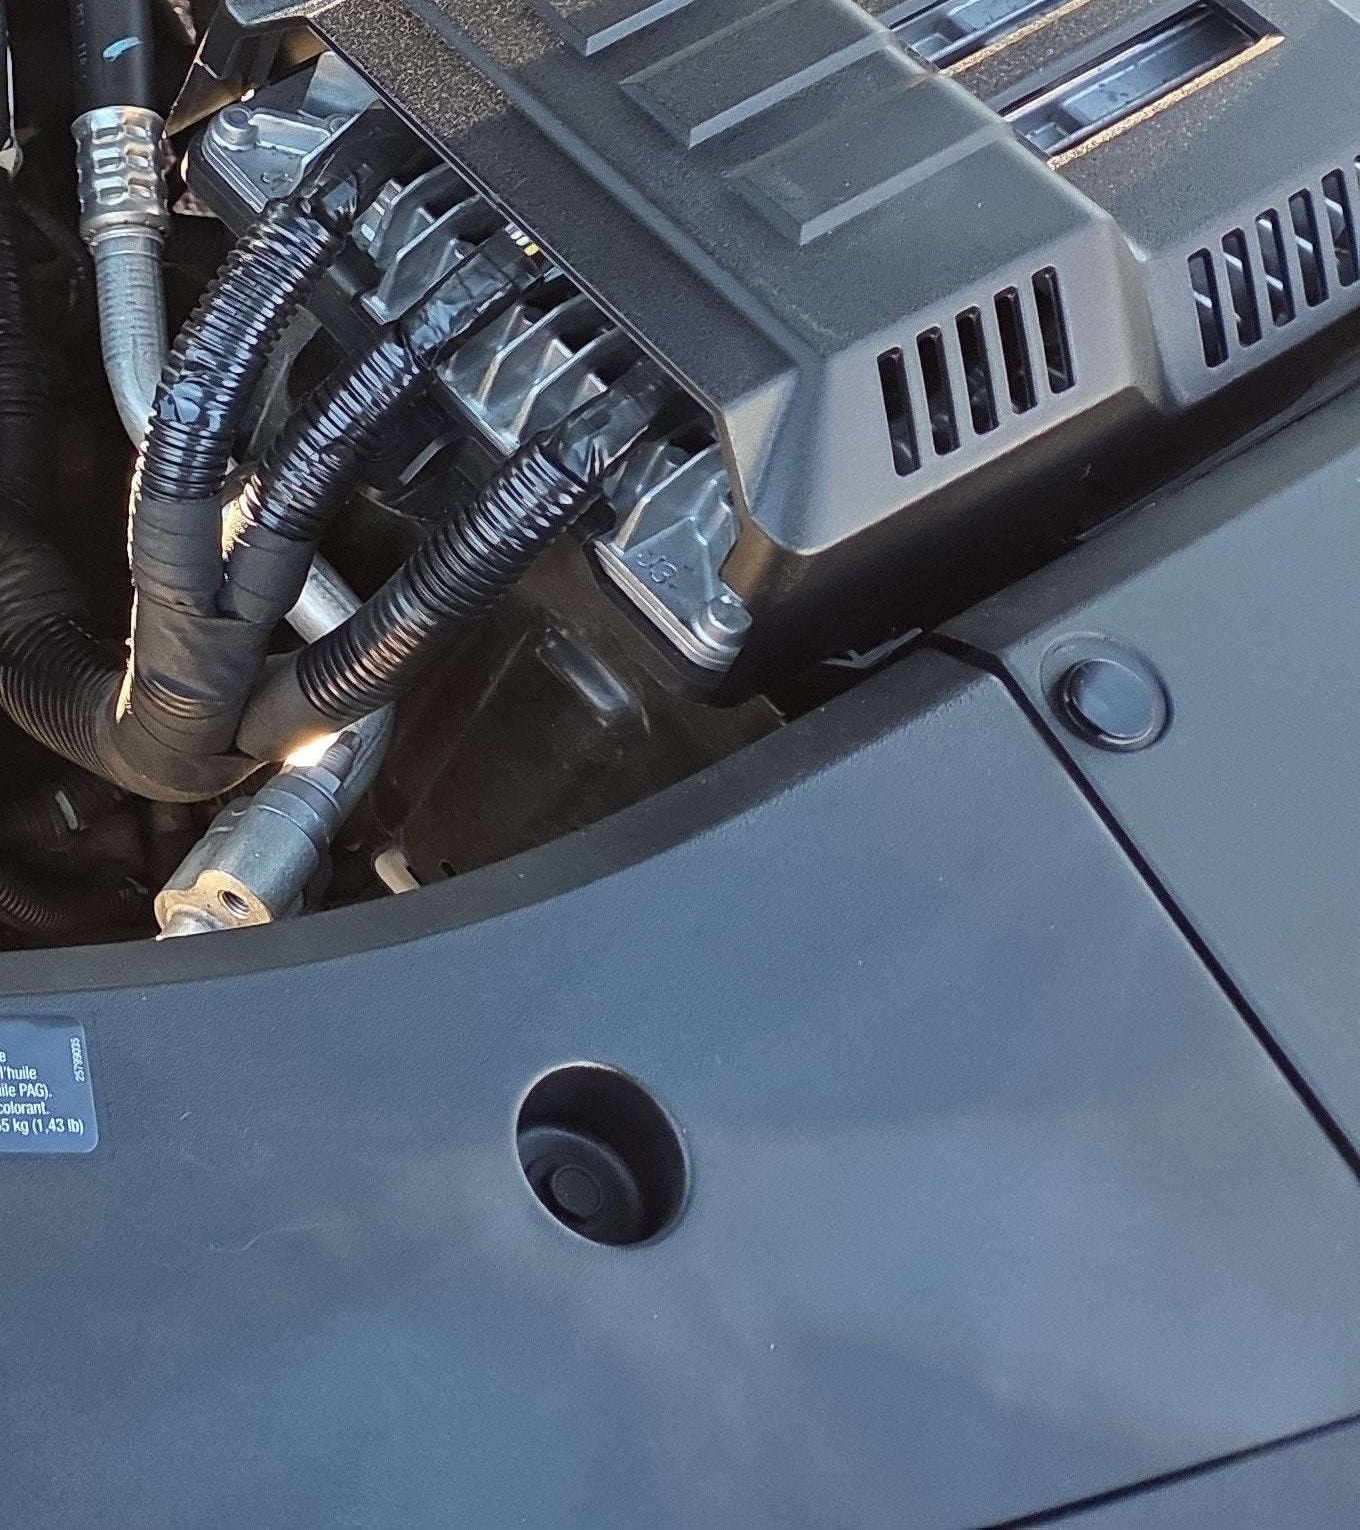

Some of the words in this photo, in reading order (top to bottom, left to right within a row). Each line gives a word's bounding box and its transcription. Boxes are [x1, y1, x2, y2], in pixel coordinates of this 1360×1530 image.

[0, 1066, 36, 1080] l'huile
[19, 1083, 52, 1100] PAG).
[13, 1118, 29, 1135] kg
[32, 1118, 64, 1134] (1,43
[68, 1119, 84, 1135] lb)
